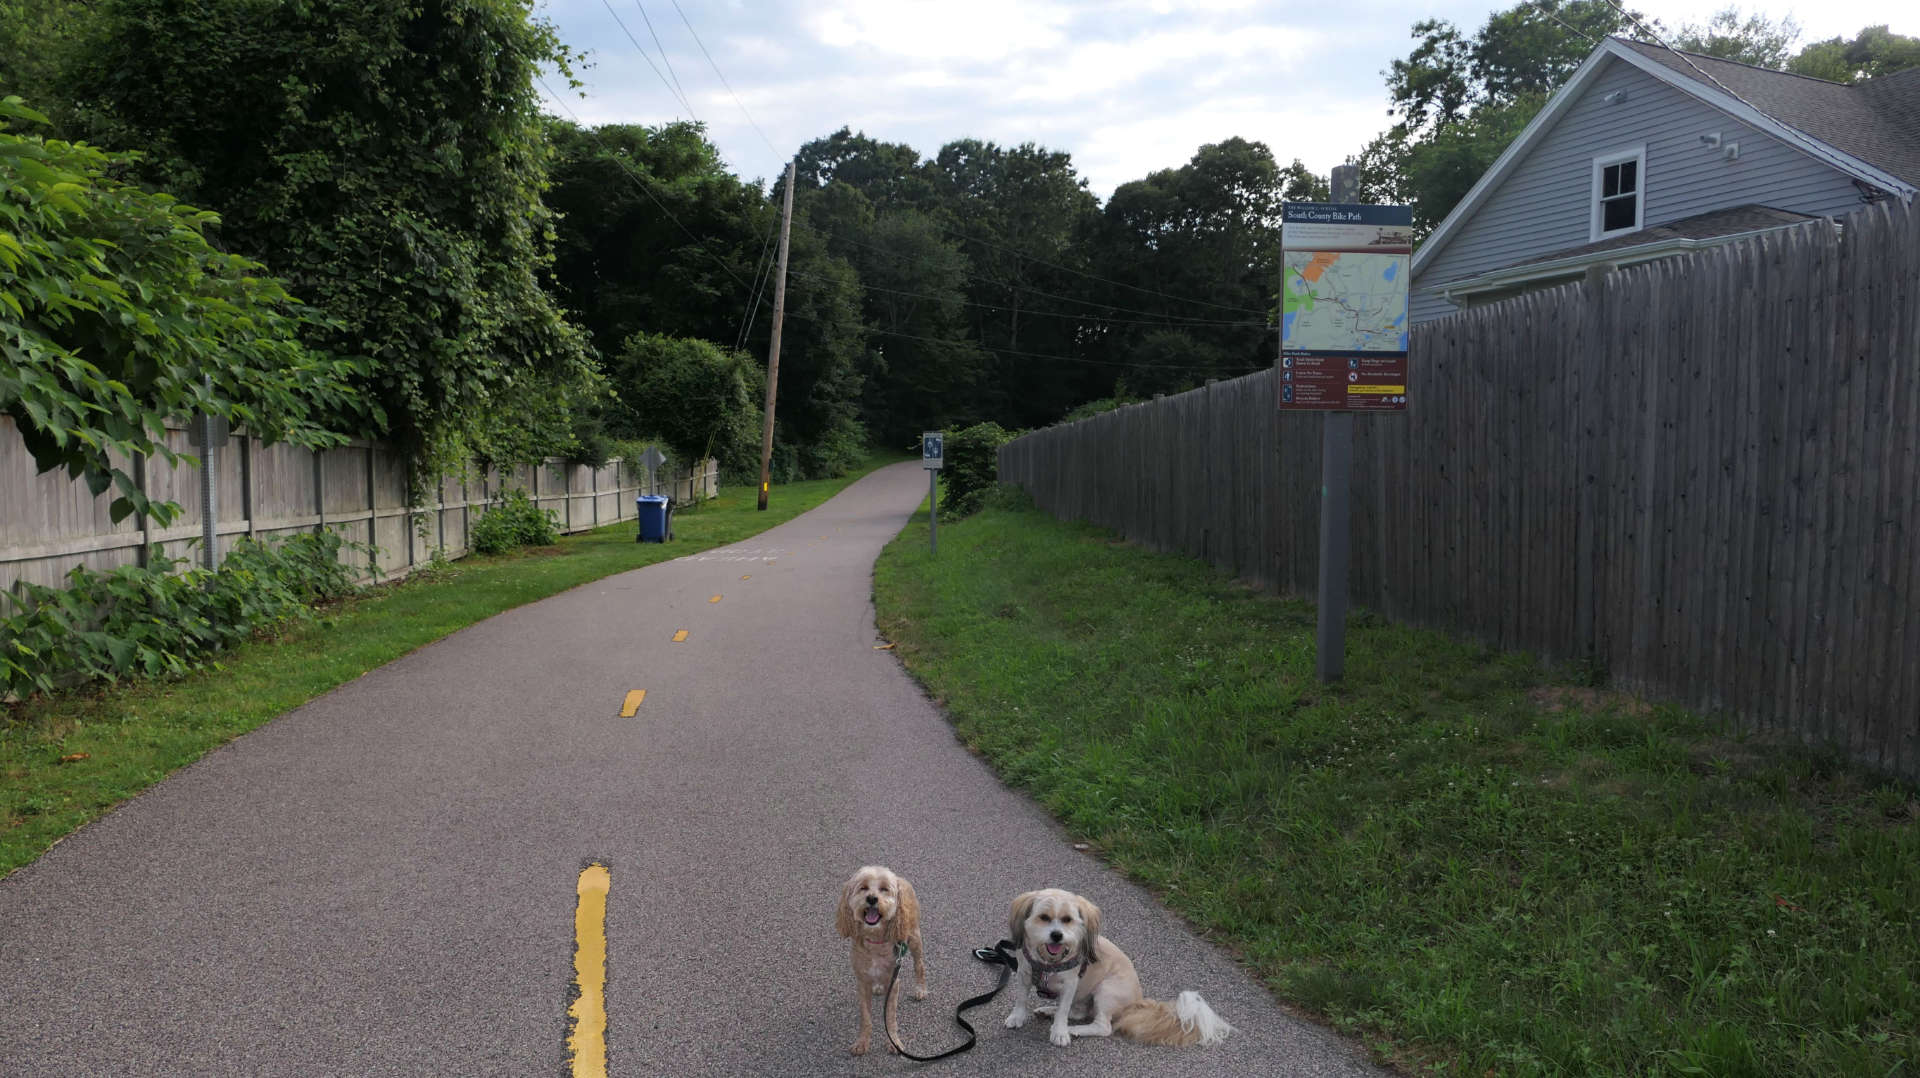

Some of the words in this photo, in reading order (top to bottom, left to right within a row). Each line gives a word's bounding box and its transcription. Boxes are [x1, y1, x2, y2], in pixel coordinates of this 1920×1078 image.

[1288, 211, 1307, 219] South
[1308, 211, 1331, 222] County
[1333, 212, 1346, 220] Bike
[1348, 212, 1361, 220] Path
